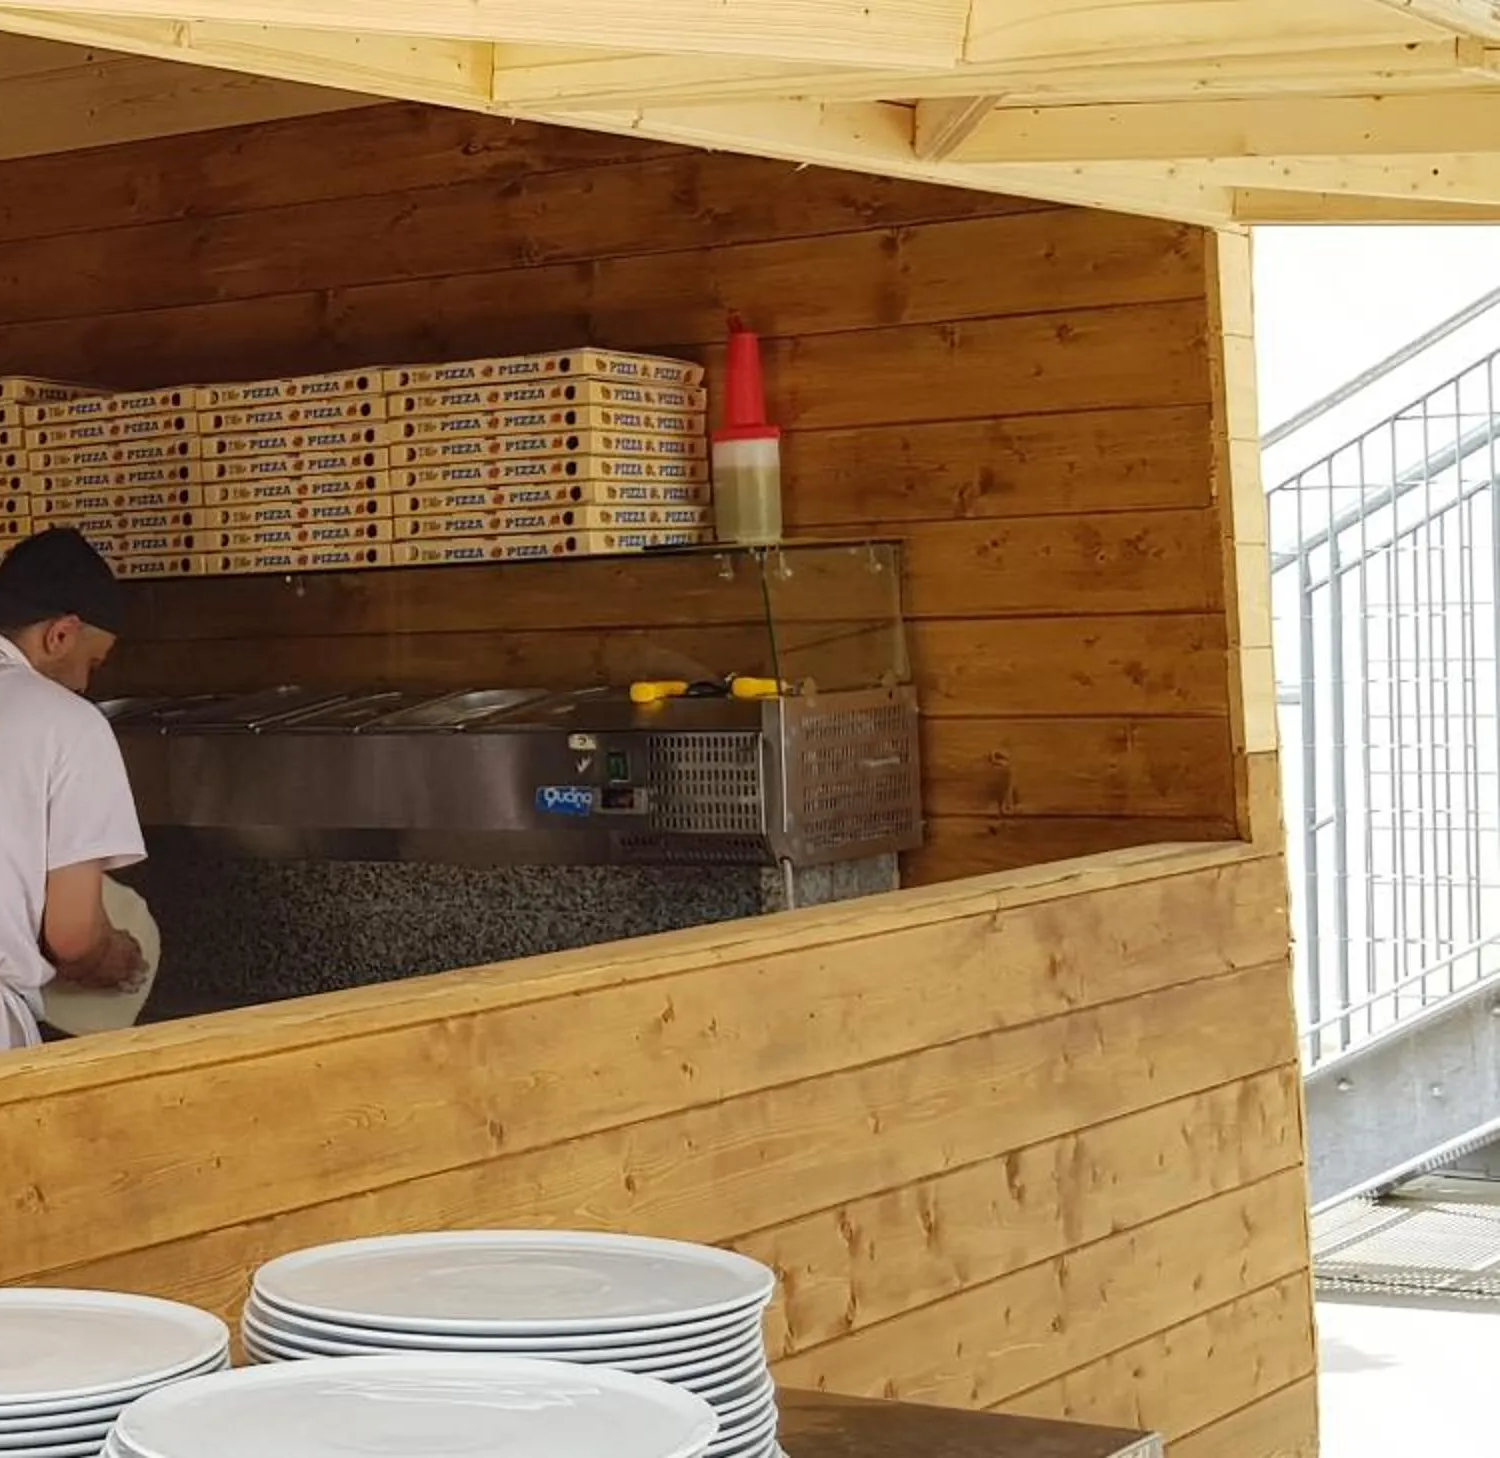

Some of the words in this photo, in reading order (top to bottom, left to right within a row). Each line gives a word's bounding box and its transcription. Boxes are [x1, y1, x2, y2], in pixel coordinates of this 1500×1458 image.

[435, 367, 476, 380] PIZZA
[498, 363, 540, 375] PIZZA
[610, 361, 638, 374] PIZZA
[654, 367, 682, 380] PIZZA
[242, 386, 281, 399] PIZZA
[301, 382, 339, 394] PIZZA
[441, 392, 481, 405] PIZZA
[504, 388, 545, 401] PIZZA
[614, 389, 642, 402] PIZZA
[658, 392, 684, 405] PIZZA
[68, 402, 102, 415] PIZZA
[121, 397, 157, 410] PIZZA
[246, 411, 283, 424] PIZZA
[304, 407, 343, 419] PIZZA
[441, 418, 481, 431] PIZZA
[504, 415, 546, 427] PIZZA
[614, 414, 641, 426] PIZZA
[657, 417, 684, 430] PIZZA
[70, 426, 105, 438] PIZZA
[124, 421, 159, 434] PIZZA
[249, 437, 287, 449] PIZZA
[307, 433, 346, 445] PIZZA
[441, 443, 481, 455] PIZZA
[505, 438, 547, 451] PIZZA
[615, 437, 643, 450] PIZZA
[659, 441, 685, 452] PIZZA
[73, 451, 109, 464] PIZZA
[127, 448, 164, 460] PIZZA
[250, 461, 288, 473] PIZZA
[308, 458, 347, 470] PIZZA
[442, 468, 481, 480] PIZZA
[505, 463, 546, 476] PIZZA
[614, 463, 643, 475] PIZZA
[659, 465, 686, 477] PIZZA
[75, 474, 109, 485] PIZZA
[129, 471, 165, 482] PIZZA
[254, 485, 291, 497] PIZZA
[312, 482, 351, 494] PIZZA
[619, 487, 647, 499] PIZZA
[663, 487, 689, 499] PIZZA
[75, 497, 109, 508] PIZZA
[129, 494, 164, 505] PIZZA
[445, 494, 485, 506] PIZZA
[509, 490, 551, 503] PIZZA
[254, 509, 291, 521] PIZZA
[312, 505, 351, 518] PIZZA
[615, 511, 646, 523] PIZZA
[665, 511, 695, 523] PIZZA
[79, 519, 113, 530] PIZZA
[132, 516, 167, 527] PIZZA
[445, 518, 484, 531] PIZZA
[505, 515, 545, 528] PIZZA
[132, 537, 168, 549] PIZZA
[254, 531, 291, 543] PIZZA
[312, 528, 350, 540] PIZZA
[619, 536, 647, 547] PIZZA
[254, 554, 291, 567] PIZZA
[312, 552, 350, 564] PIZZA
[445, 547, 484, 560] PIZZA
[507, 544, 548, 557] PIZZA
[130, 561, 165, 573] PIZZA
